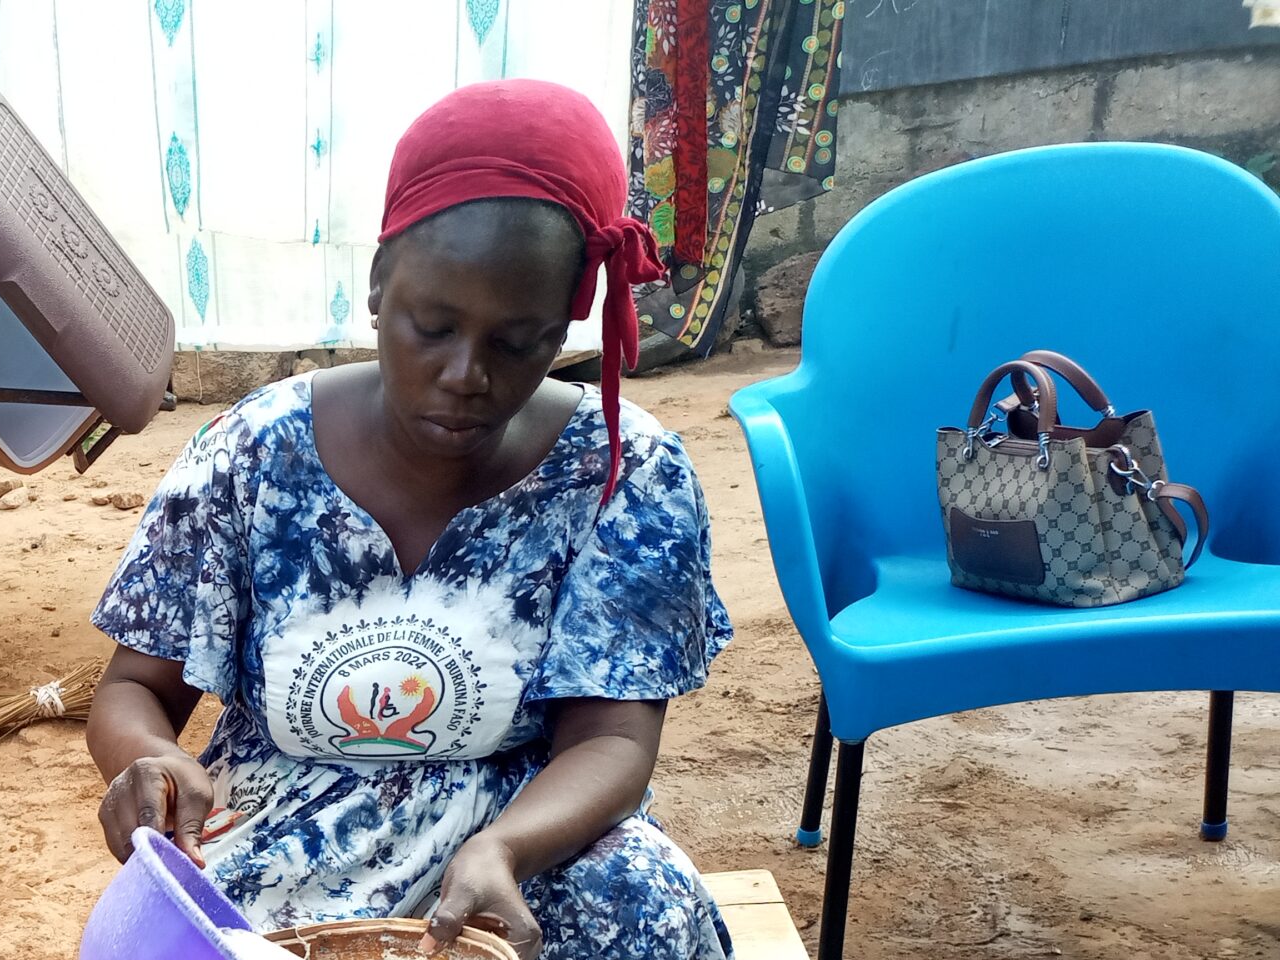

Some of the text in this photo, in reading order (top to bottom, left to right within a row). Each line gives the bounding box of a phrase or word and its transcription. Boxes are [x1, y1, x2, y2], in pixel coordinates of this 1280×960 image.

[377, 631, 392, 643] DE
[407, 631, 445, 657] FEMME
[303, 634, 375, 699] INTERNATIONALE
[338, 651, 427, 678] 8 MARS 2024
[445, 658, 468, 707] BURKINA
[446, 708, 466, 731] FASO
